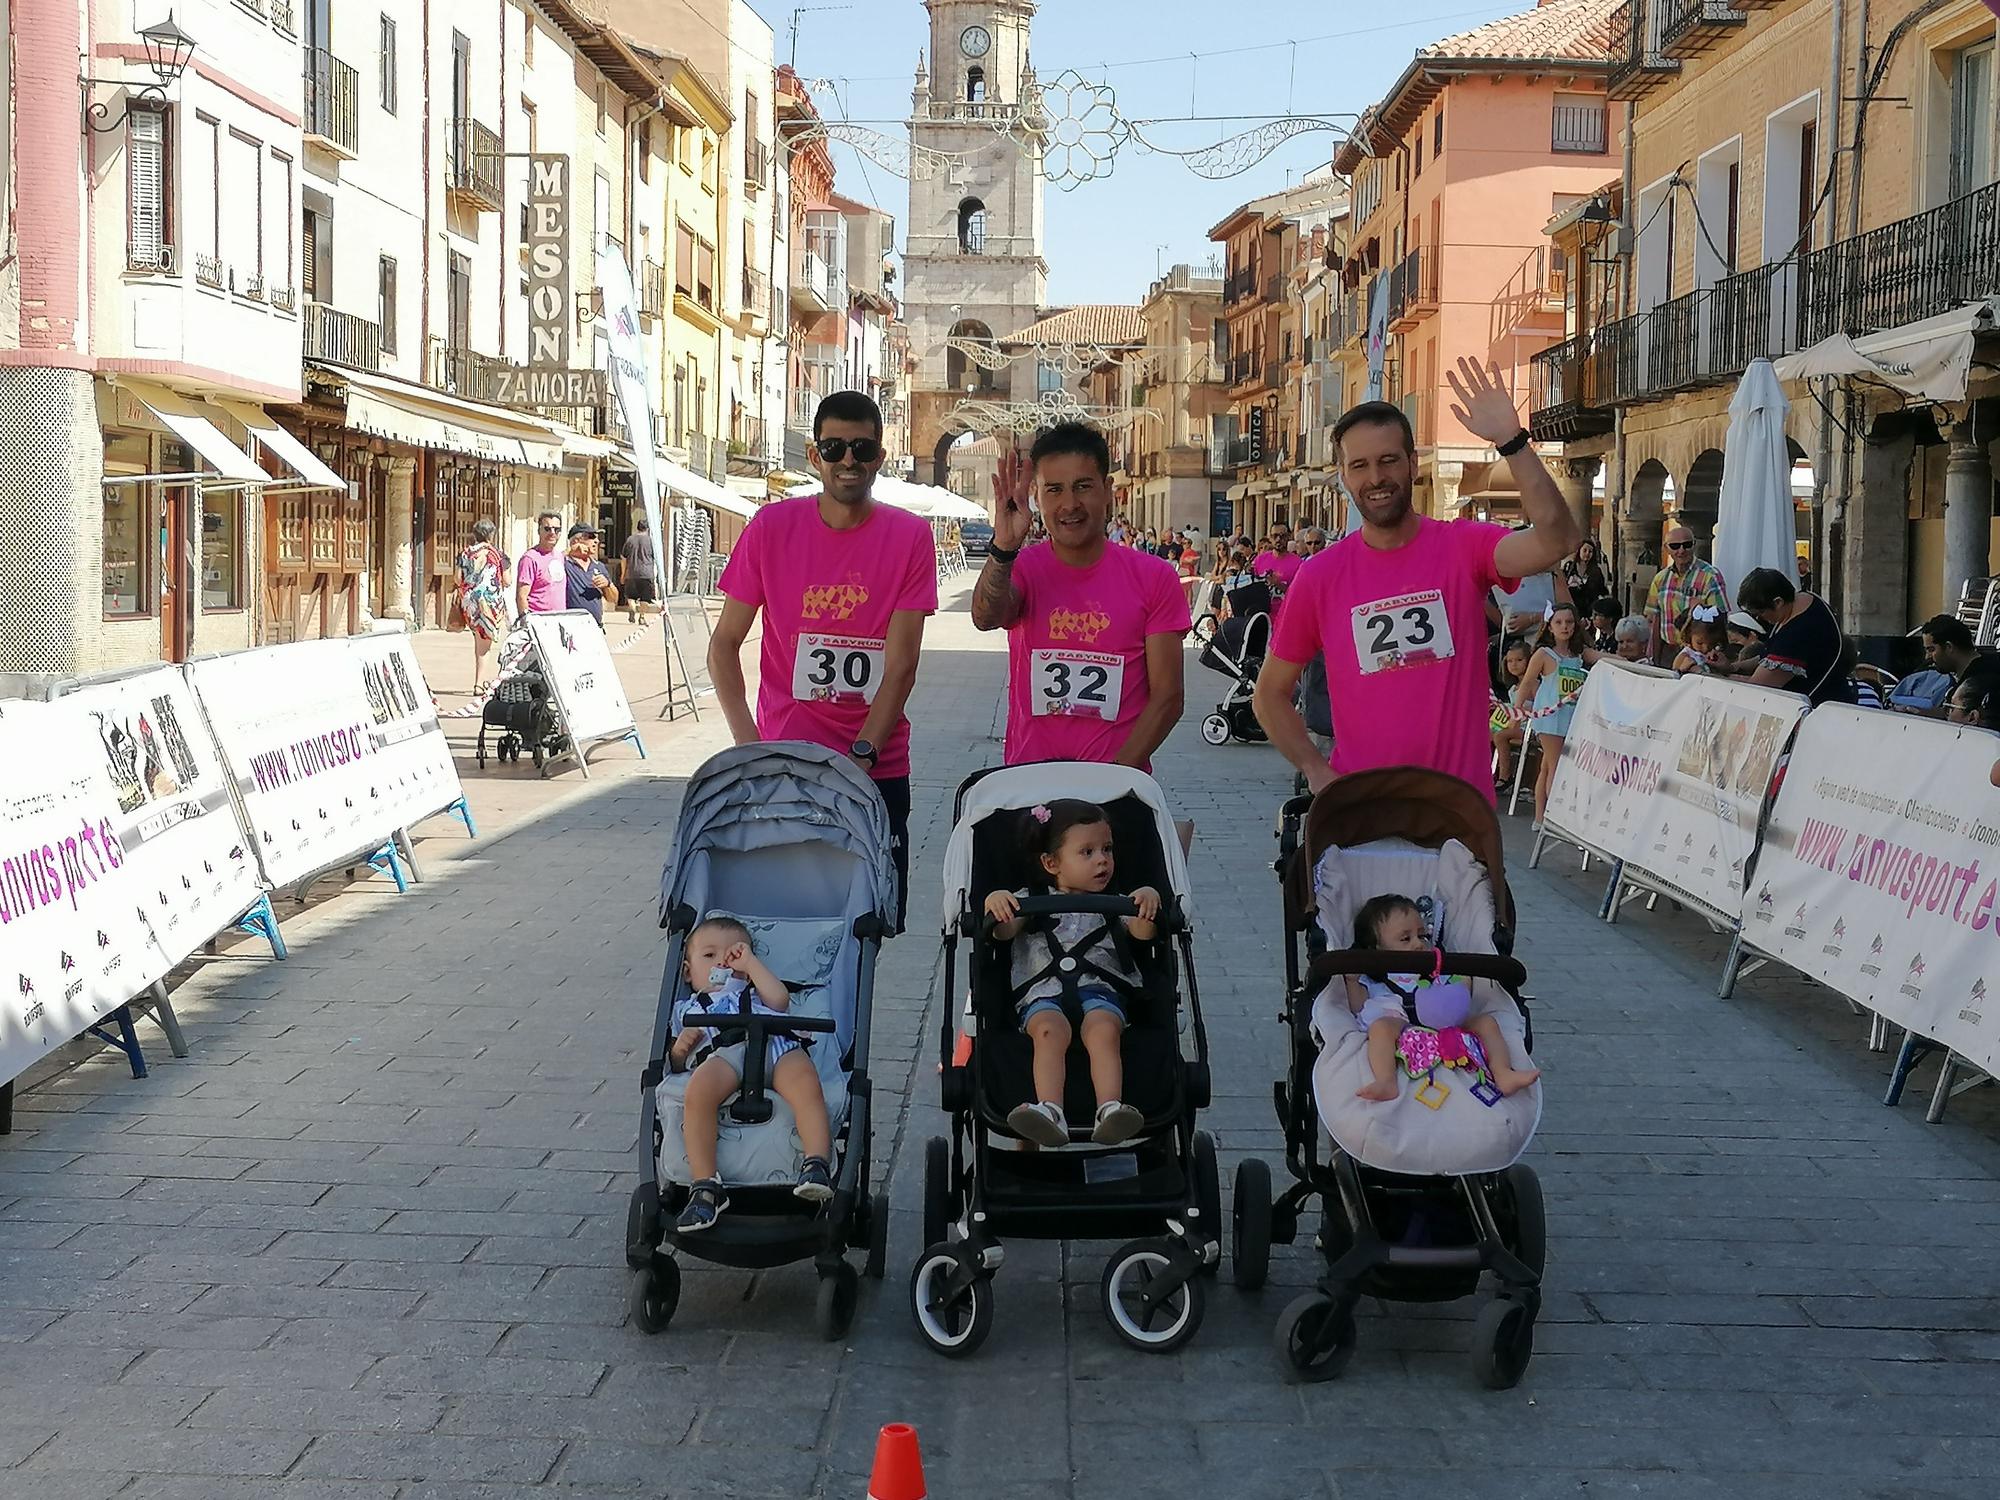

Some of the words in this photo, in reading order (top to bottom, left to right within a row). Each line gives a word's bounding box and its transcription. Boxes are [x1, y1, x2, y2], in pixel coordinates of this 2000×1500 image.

[533, 161, 563, 362] MESON
[496, 371, 599, 404] ZAMORA
[1374, 592, 1437, 609] BABYRUN
[823, 637, 882, 648] BABYRUN
[1366, 606, 1435, 654] 23
[807, 648, 871, 688] 30
[1058, 652, 1118, 663] BABYRUN
[1043, 663, 1108, 702] 32
[1794, 817, 2000, 938] www.runvasport.e
